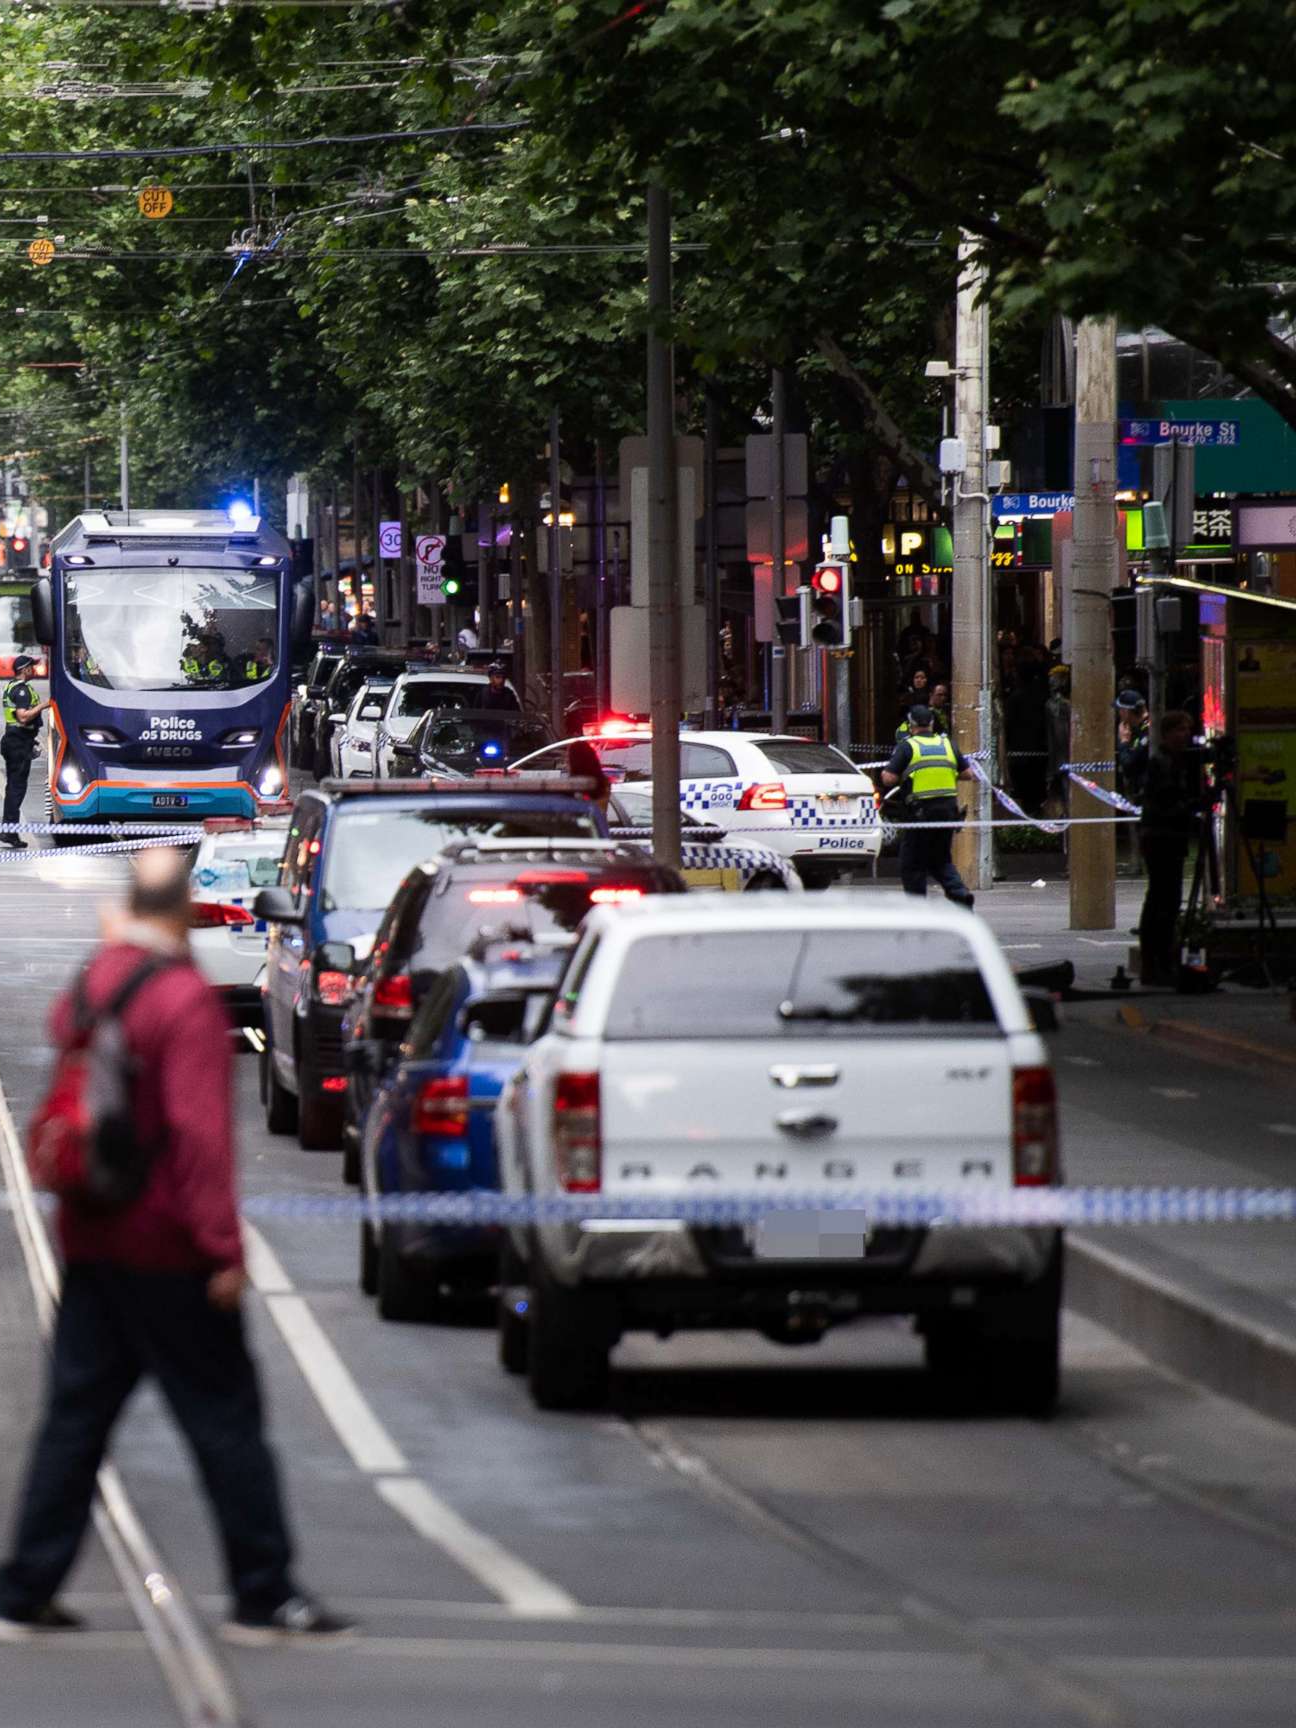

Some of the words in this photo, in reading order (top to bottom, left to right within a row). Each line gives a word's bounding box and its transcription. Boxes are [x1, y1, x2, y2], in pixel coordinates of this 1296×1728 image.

[142, 190, 167, 201] CUT
[143, 202, 167, 213] OFF
[32, 241, 50, 251] CUT
[1159, 422, 1213, 437] Bourke
[1218, 422, 1236, 437] St
[1216, 436, 1235, 445] 352
[1029, 494, 1076, 508] Bourke
[384, 533, 401, 546] 30
[423, 565, 439, 574] NO
[895, 563, 913, 574] ON
[150, 716, 196, 730] Police
[138, 730, 158, 741] .05
[159, 730, 203, 741] DRUGS
[146, 746, 192, 757] IVECO
[710, 792, 733, 801] 000
[819, 837, 865, 849] Police
[620, 1160, 993, 1180] RANGER
